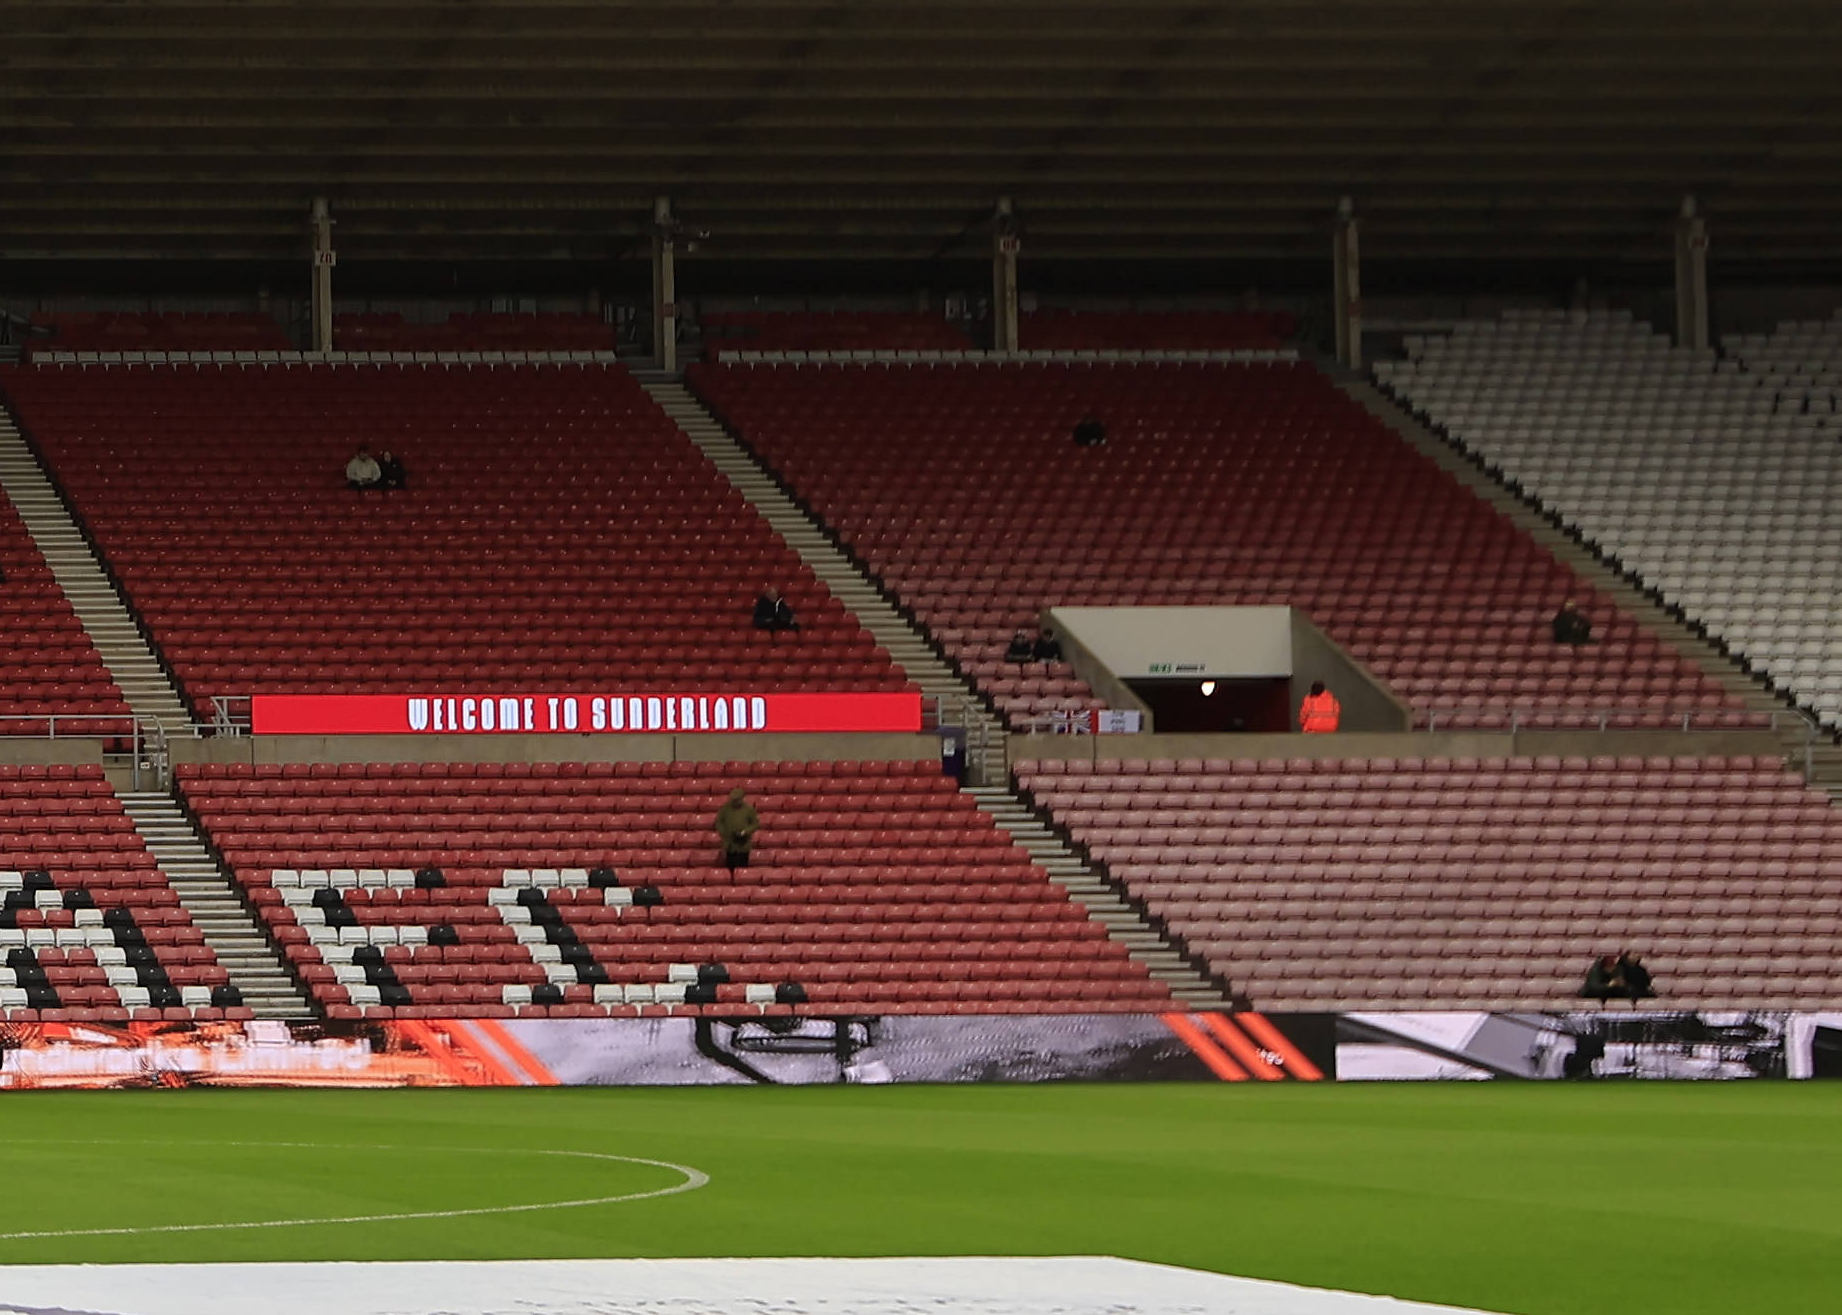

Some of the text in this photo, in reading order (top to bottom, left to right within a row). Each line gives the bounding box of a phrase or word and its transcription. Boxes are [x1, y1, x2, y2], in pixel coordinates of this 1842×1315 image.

[407, 696, 766, 731] WELCOME TO SUNDERLAND
